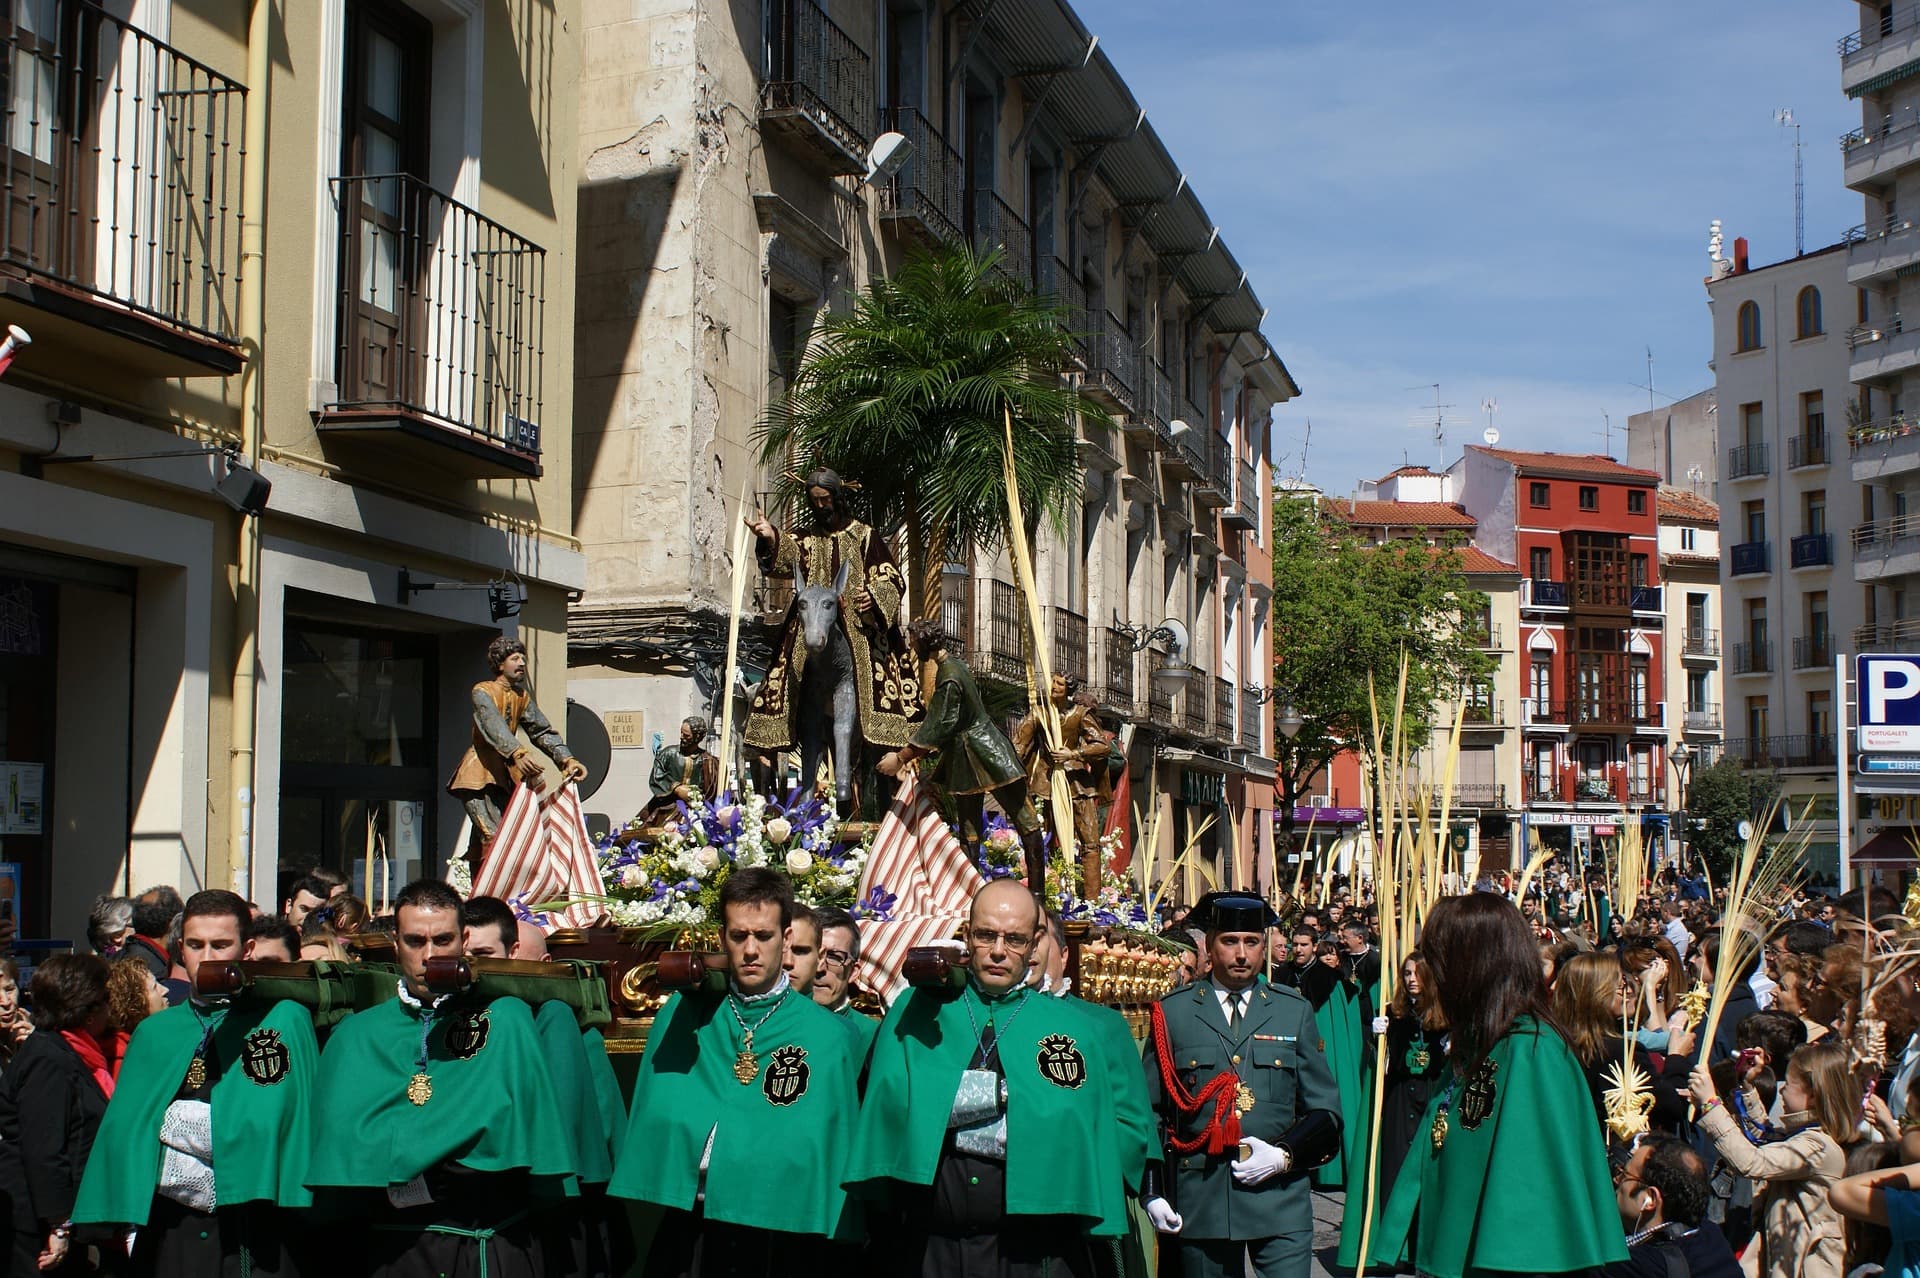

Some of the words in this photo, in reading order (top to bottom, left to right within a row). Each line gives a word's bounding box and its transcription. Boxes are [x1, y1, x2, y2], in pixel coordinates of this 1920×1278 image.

[1868, 660, 1920, 723] P
[613, 715, 633, 723] CALLE
[612, 725, 620, 733] DE
[622, 725, 634, 733] LOS
[611, 735, 633, 743] TINTES
[1552, 814, 1564, 823] LA
[1570, 814, 1609, 824] FUENTE
